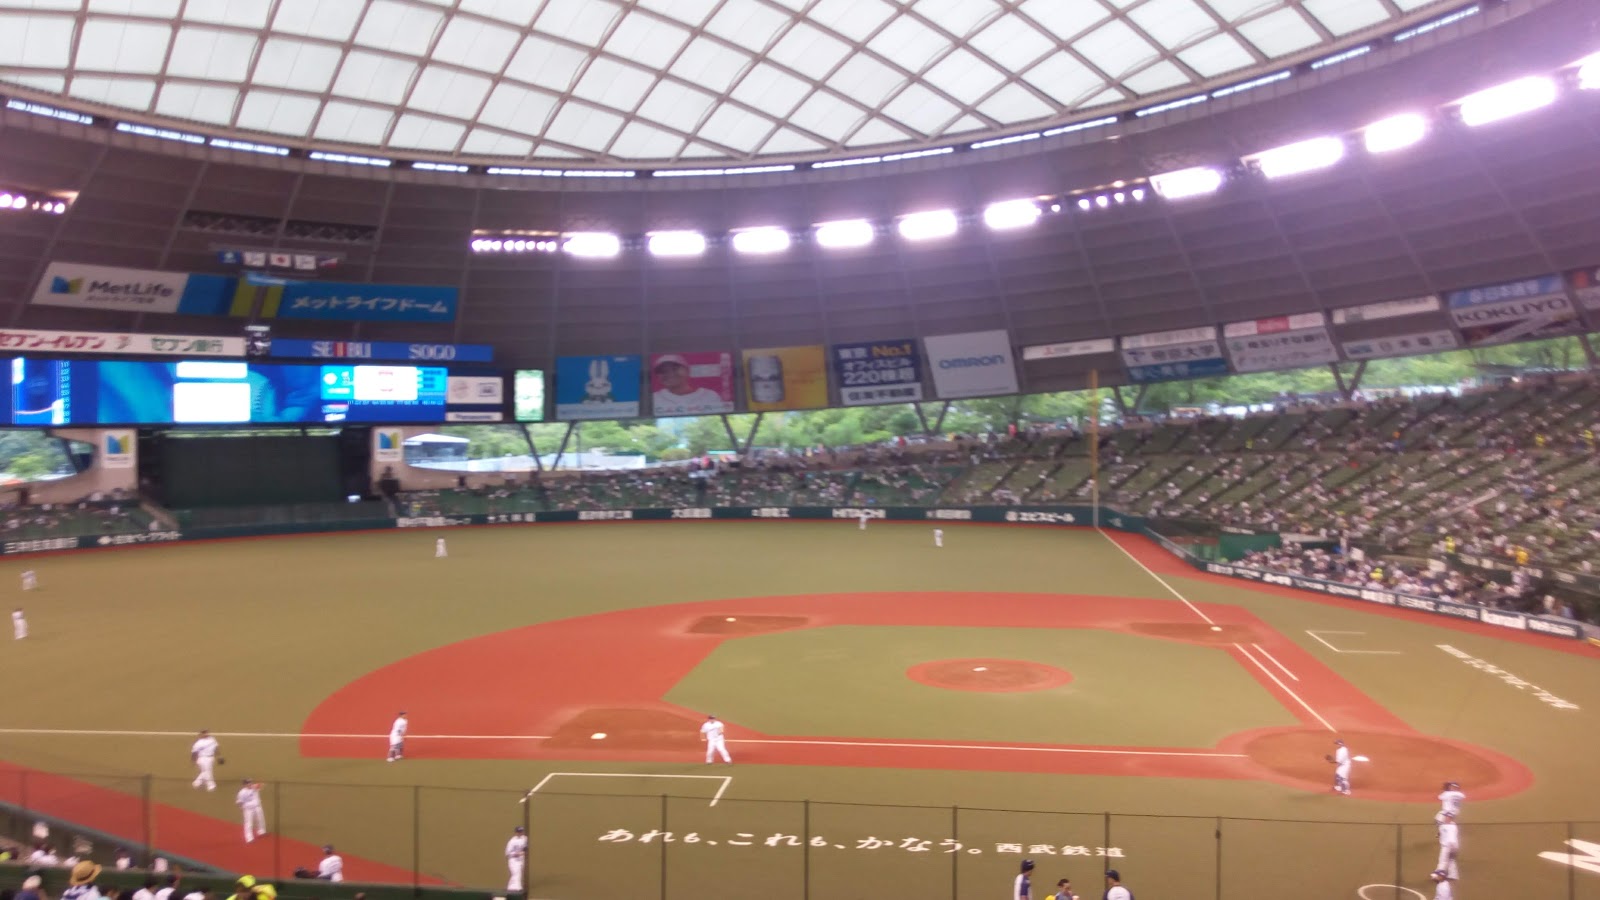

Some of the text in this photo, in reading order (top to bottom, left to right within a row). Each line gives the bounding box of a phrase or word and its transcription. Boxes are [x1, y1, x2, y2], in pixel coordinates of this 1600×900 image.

[88, 281, 174, 297] MetLife
[291, 295, 448, 313] メットライフドーム
[1456, 298, 1567, 323] KOKUYO
[312, 341, 372, 358] SEIBU
[408, 344, 456, 359] SOGO
[598, 828, 1126, 858] あれも、これも、かなう。 西武鉄道
